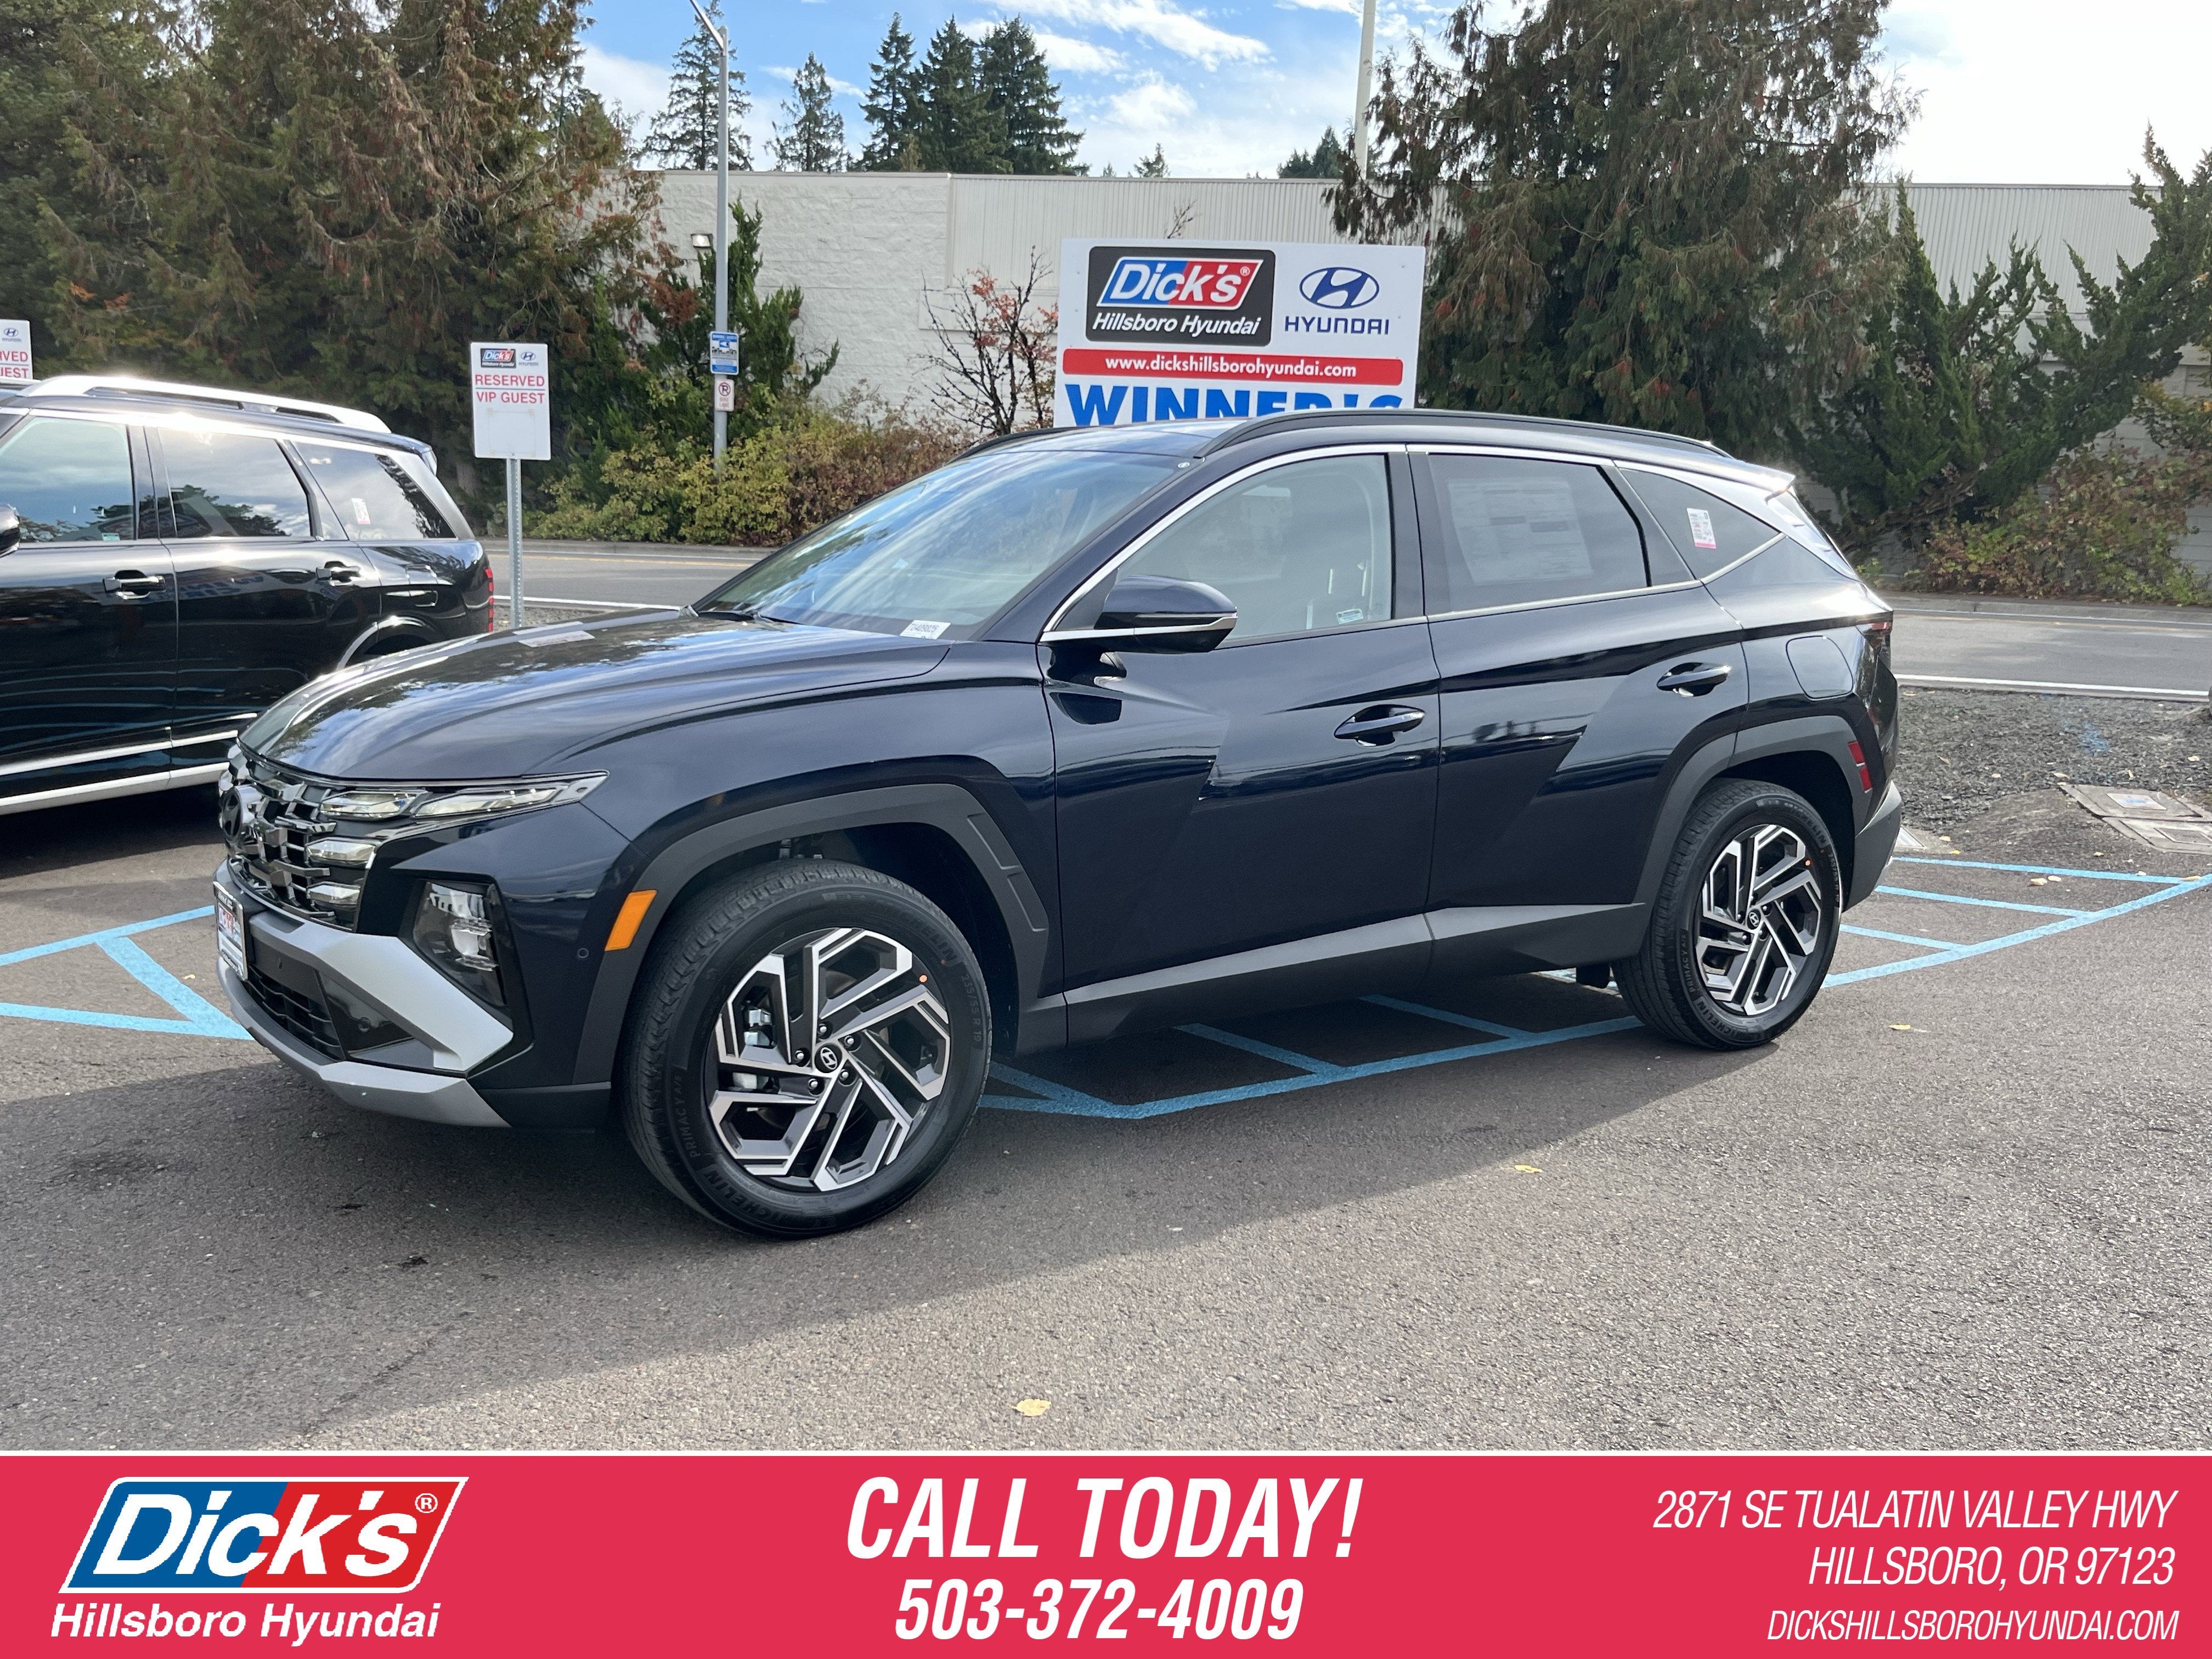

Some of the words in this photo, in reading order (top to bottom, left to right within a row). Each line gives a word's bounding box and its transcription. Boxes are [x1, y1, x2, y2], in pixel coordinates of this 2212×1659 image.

[1110, 263, 1242, 303] Dick's
[1092, 312, 1178, 332] Hillsboro
[1180, 314, 1261, 337] Hyundai
[1284, 315, 1389, 335] HYUNDAI
[475, 374, 545, 387] RESERVED
[1105, 354, 1356, 379] www.dickshillsborohyundai.com
[477, 392, 496, 403] VIP
[501, 392, 545, 404] GUEST
[1065, 384, 1402, 427] WINN'
[1681, 949, 1696, 992] PRIMACY
[1696, 1001, 1744, 1039] ICHELIN
[673, 1096, 701, 1158] PRIMACY
[703, 1169, 789, 1225] ICHELIN
